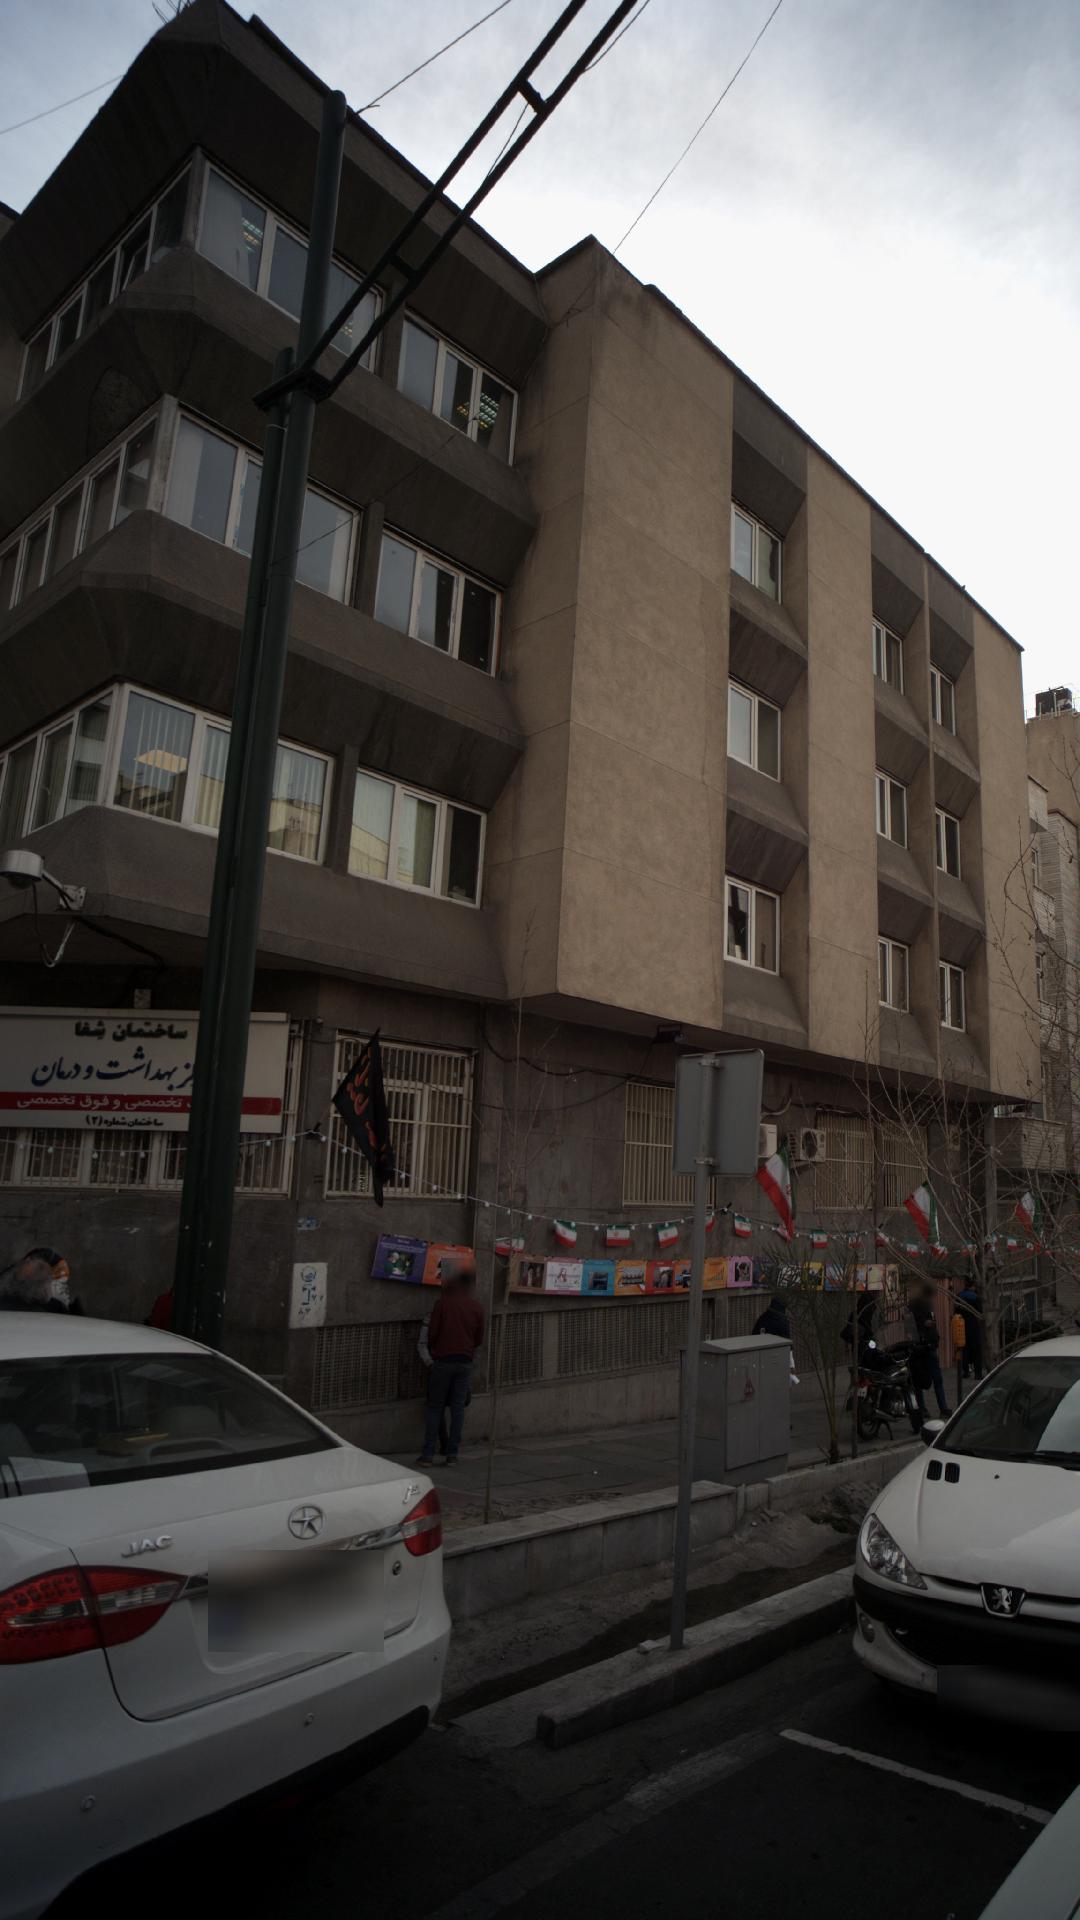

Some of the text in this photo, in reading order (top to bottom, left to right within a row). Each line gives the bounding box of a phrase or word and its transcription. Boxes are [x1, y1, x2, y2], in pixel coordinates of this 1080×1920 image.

[113, 1021, 187, 1041] ساختمان
[32, 1057, 81, 1087] درمان
[83, 1064, 94, 1080] و
[96, 1046, 178, 1091] بهداشت
[16, 1094, 76, 1109] تخصصی
[79, 1096, 110, 1111] فوق
[112, 1099, 121, 1110] و
[124, 1095, 182, 1111] تخصصی
[104, 1116, 127, 1127] شماره
[127, 1116, 164, 1127] ساختمان
[121, 1535, 173, 1559] JAC
